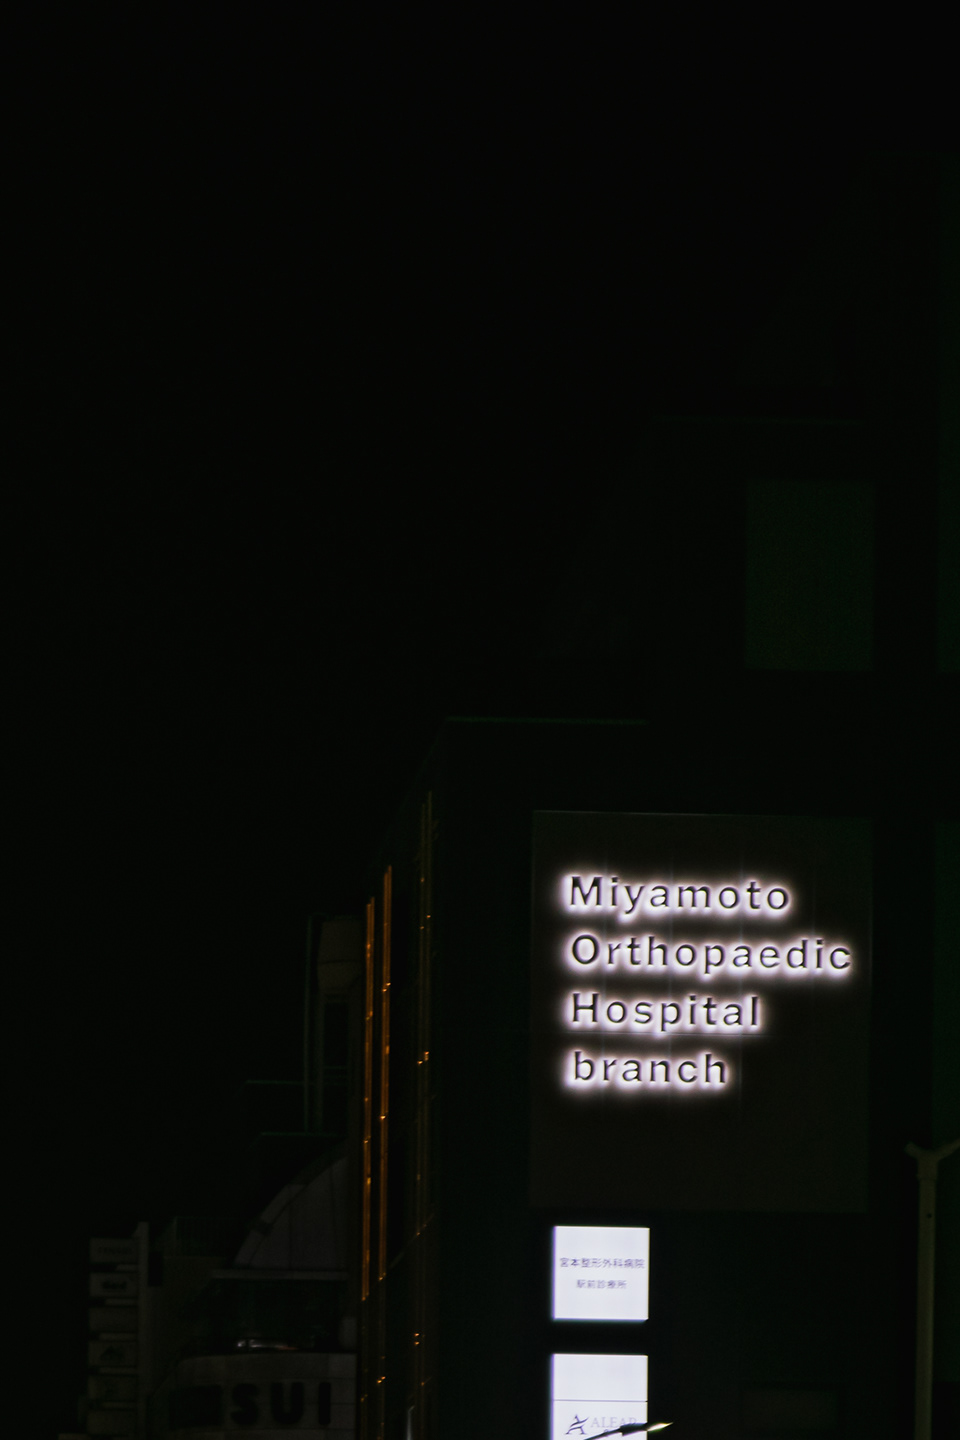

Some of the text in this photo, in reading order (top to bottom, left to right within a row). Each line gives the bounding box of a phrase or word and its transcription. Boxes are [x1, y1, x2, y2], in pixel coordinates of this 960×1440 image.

[569, 875, 790, 915] Miyamoto
[571, 934, 852, 974] Orthopaedic
[572, 993, 759, 1032] Hospital
[573, 1052, 726, 1083] branch
[559, 1257, 645, 1269] 宮本整形外科病院
[576, 1279, 627, 1290] 駅前診療所
